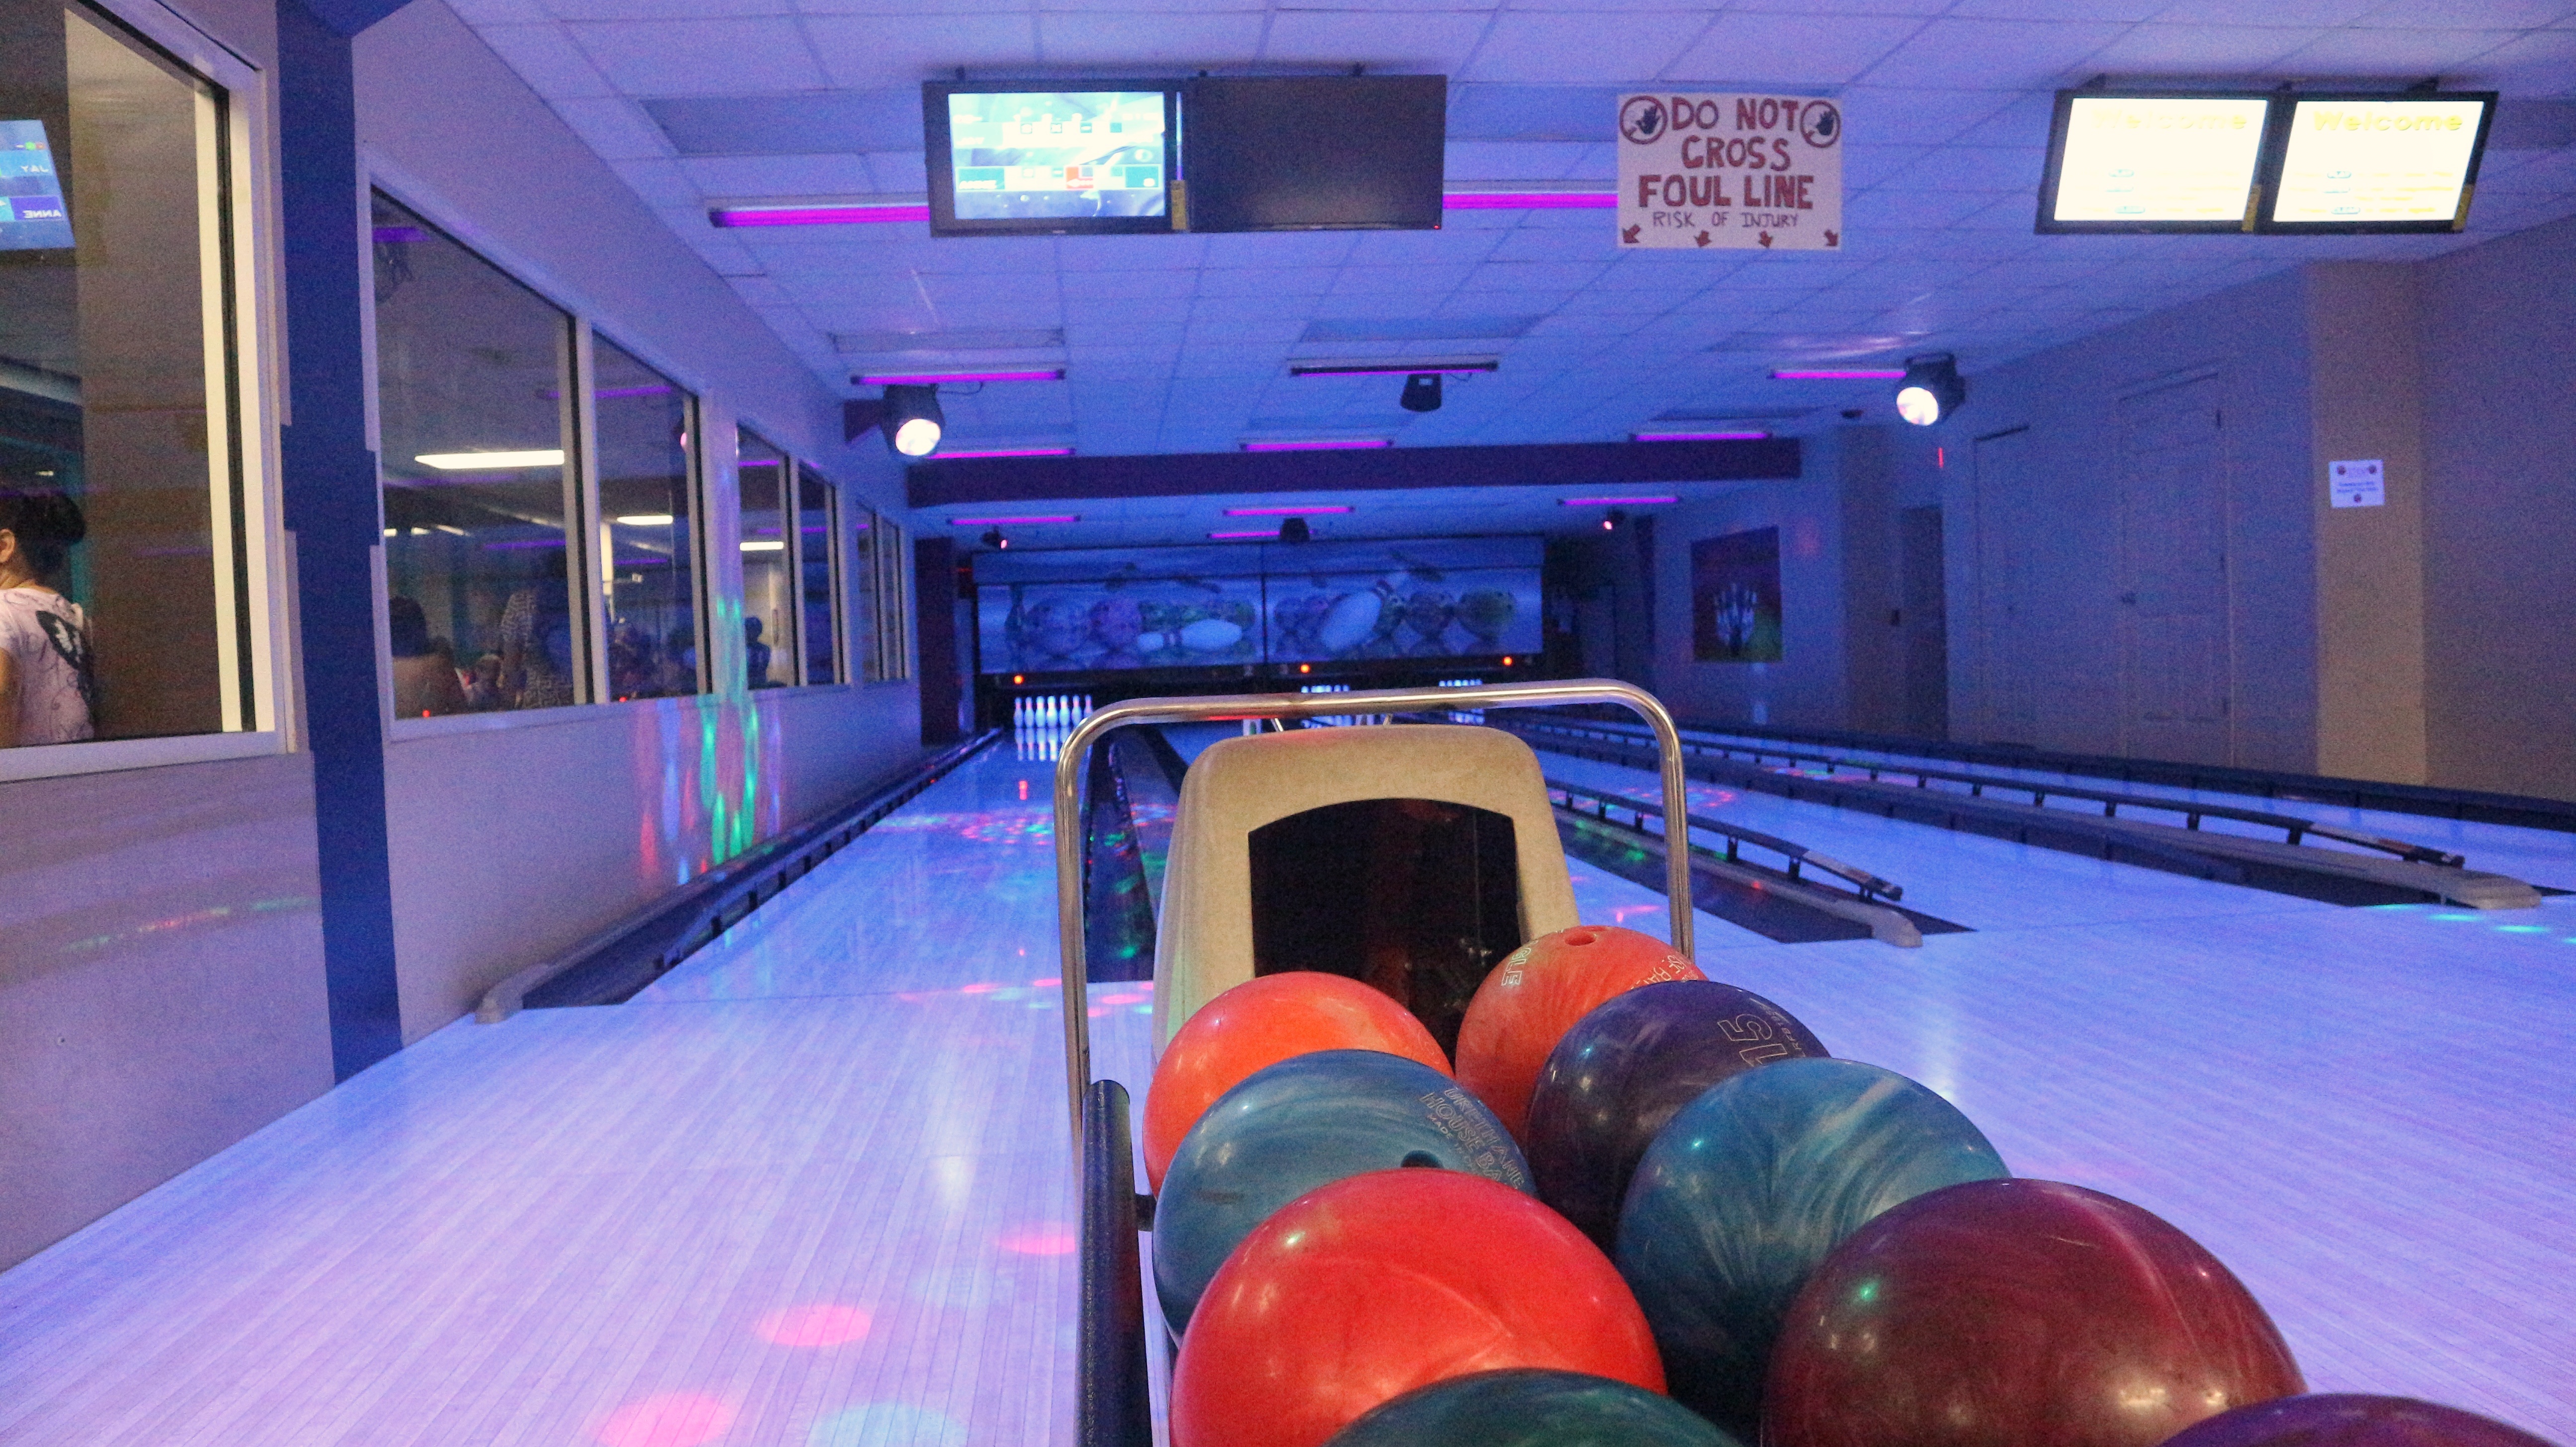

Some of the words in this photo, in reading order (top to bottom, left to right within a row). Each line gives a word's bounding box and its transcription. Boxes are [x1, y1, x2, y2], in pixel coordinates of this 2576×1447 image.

[1672, 96, 1719, 129] DO
[1736, 97, 1799, 131] NOT
[2091, 108, 2248, 130] Welcome
[2313, 110, 2463, 131] Welcome
[1682, 135, 1791, 171] CROSS
[1638, 174, 1732, 208] FOUL
[1743, 175, 1814, 209] LINE
[1653, 212, 1695, 227] RISK
[1712, 212, 1730, 227] OF
[1742, 212, 1799, 228] INJURY
[1717, 1014, 1788, 1067] 15
[1419, 1091, 1486, 1152] HOUSE
[1427, 1113, 1454, 1139] MADE
[1444, 1088, 1525, 1190] URETHANE
